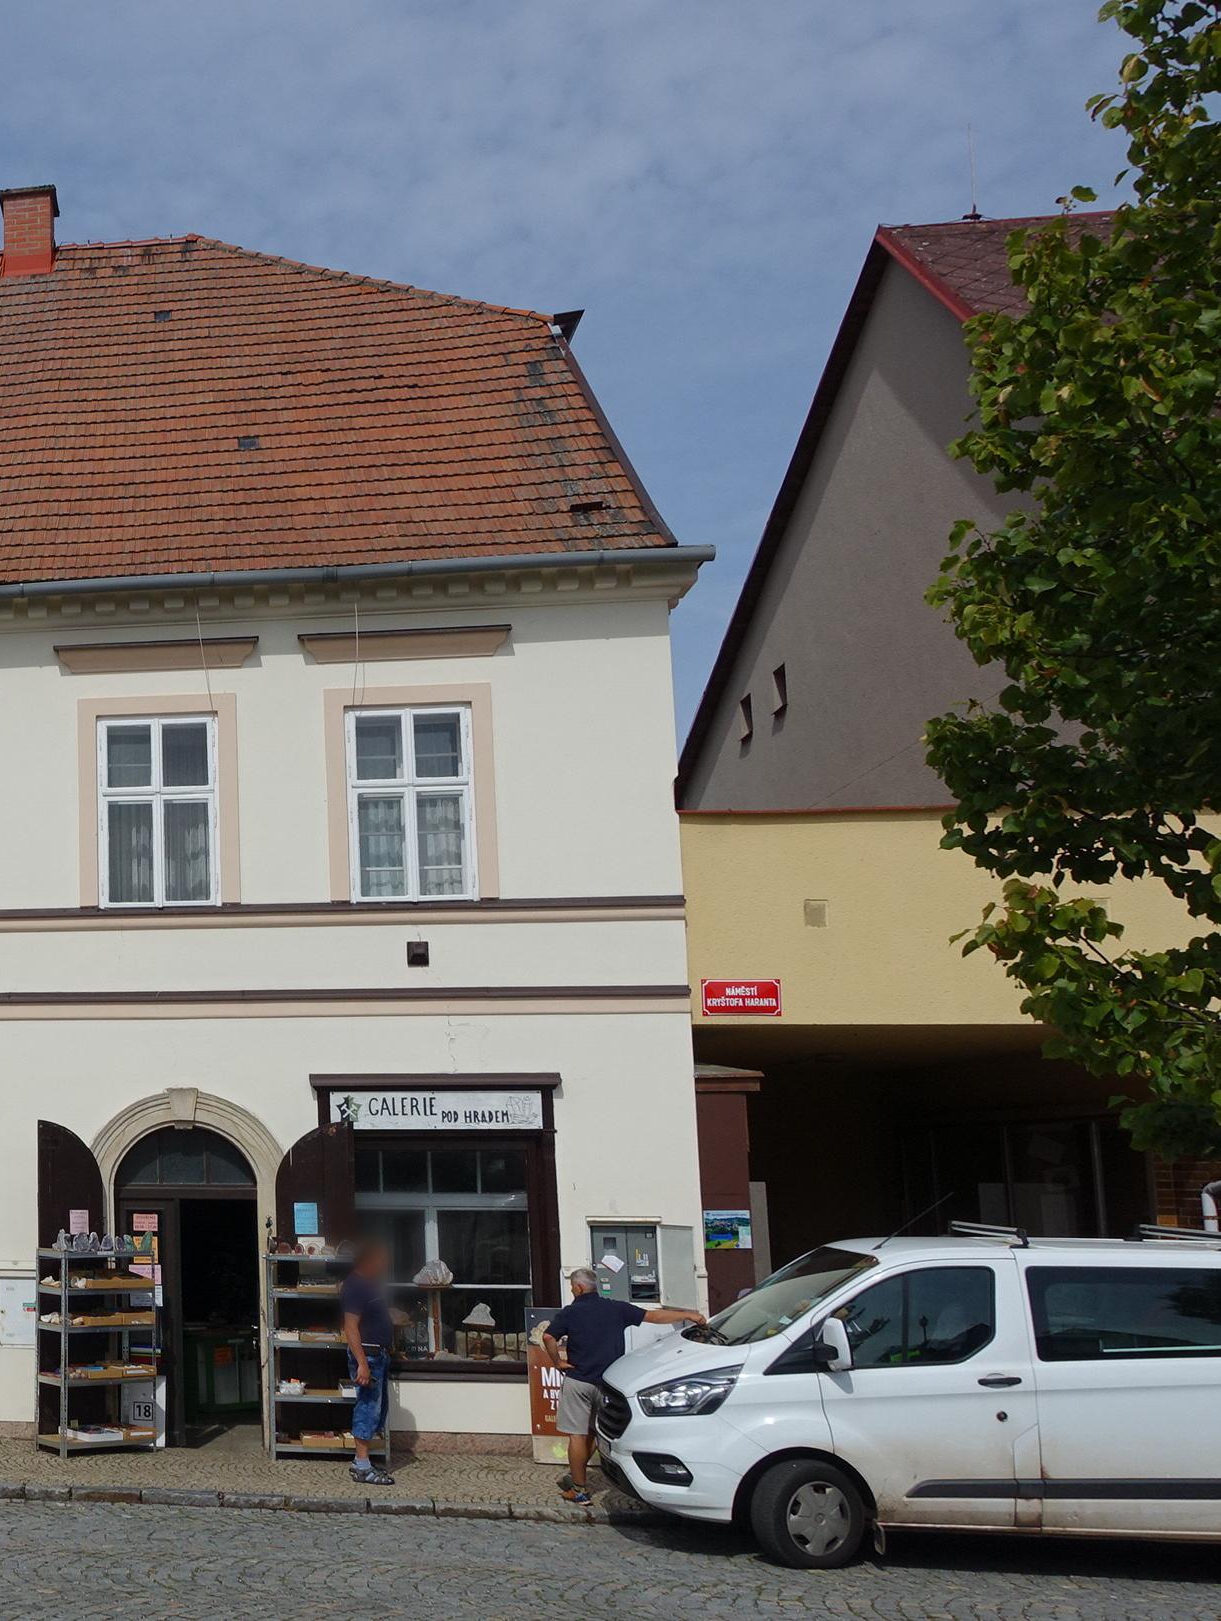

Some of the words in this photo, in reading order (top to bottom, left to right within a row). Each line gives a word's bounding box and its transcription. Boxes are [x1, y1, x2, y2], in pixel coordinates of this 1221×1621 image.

[725, 986, 757, 995] NÁMĚSTÍ
[707, 996, 743, 1006] KRYŠTOFA
[745, 998, 776, 1006] HARANTA
[368, 1097, 437, 1116] GALERIE
[441, 1110, 459, 1123] POD
[464, 1110, 510, 1123] HRADEM
[543, 1389, 549, 1399] A
[550, 1400, 556, 1410] Z
[136, 1404, 151, 1417] 18
